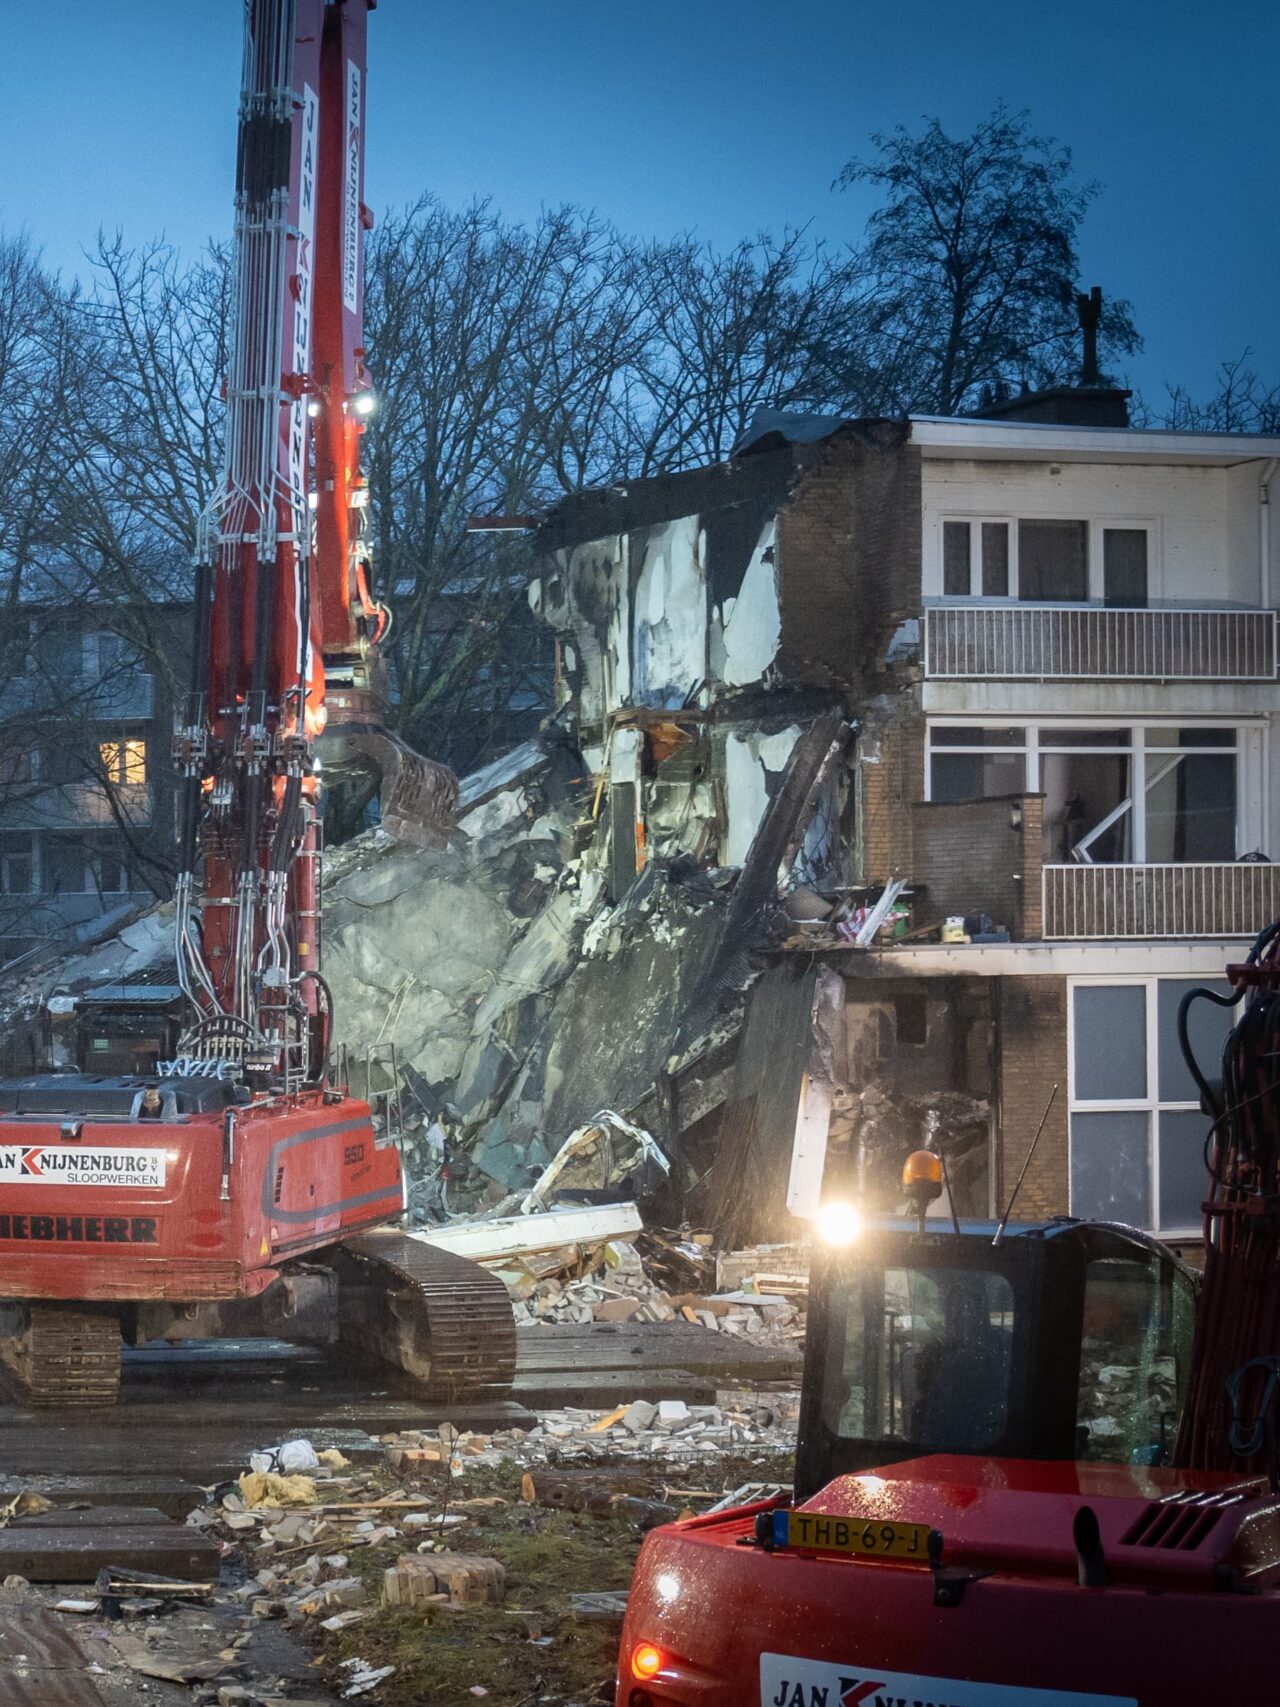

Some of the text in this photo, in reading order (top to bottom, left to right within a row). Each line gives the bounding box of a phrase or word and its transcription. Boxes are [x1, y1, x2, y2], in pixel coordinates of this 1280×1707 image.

[302, 100, 315, 212] JAN
[19, 1148, 147, 1175] KNIJNENBURG
[67, 1173, 158, 1185] SLOOPWERKEN
[798, 1518, 919, 1552] THB-69-J
[774, 1680, 829, 1707] JAN
